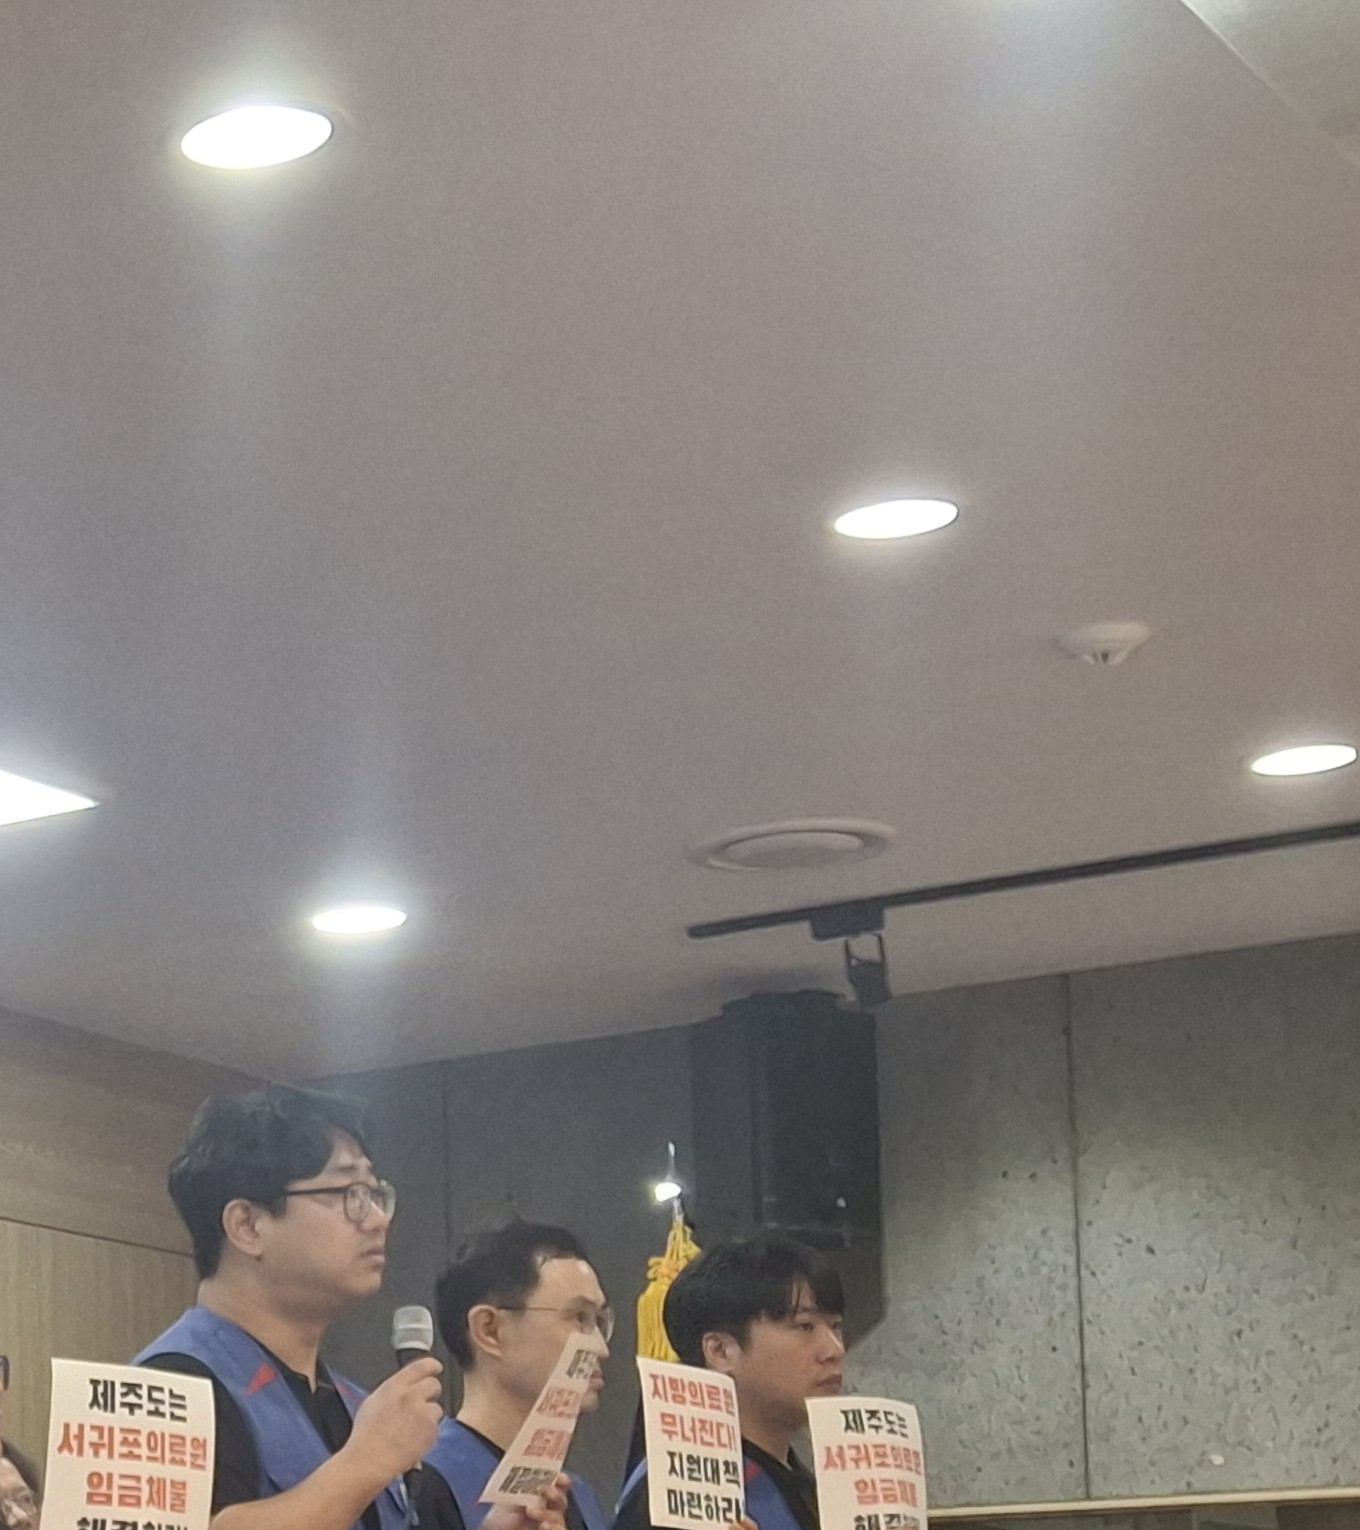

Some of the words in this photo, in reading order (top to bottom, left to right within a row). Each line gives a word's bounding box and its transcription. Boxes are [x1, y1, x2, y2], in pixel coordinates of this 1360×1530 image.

[88, 1378, 188, 1424] 제주도는
[649, 1372, 736, 1417] 지방의료원
[840, 1408, 909, 1439] 제주도는
[57, 1422, 208, 1472] 서귀포의료원
[823, 1443, 923, 1477] 서귀포의료원
[666, 1450, 741, 1490] 지원대책
[85, 1471, 187, 1515] 임금체불
